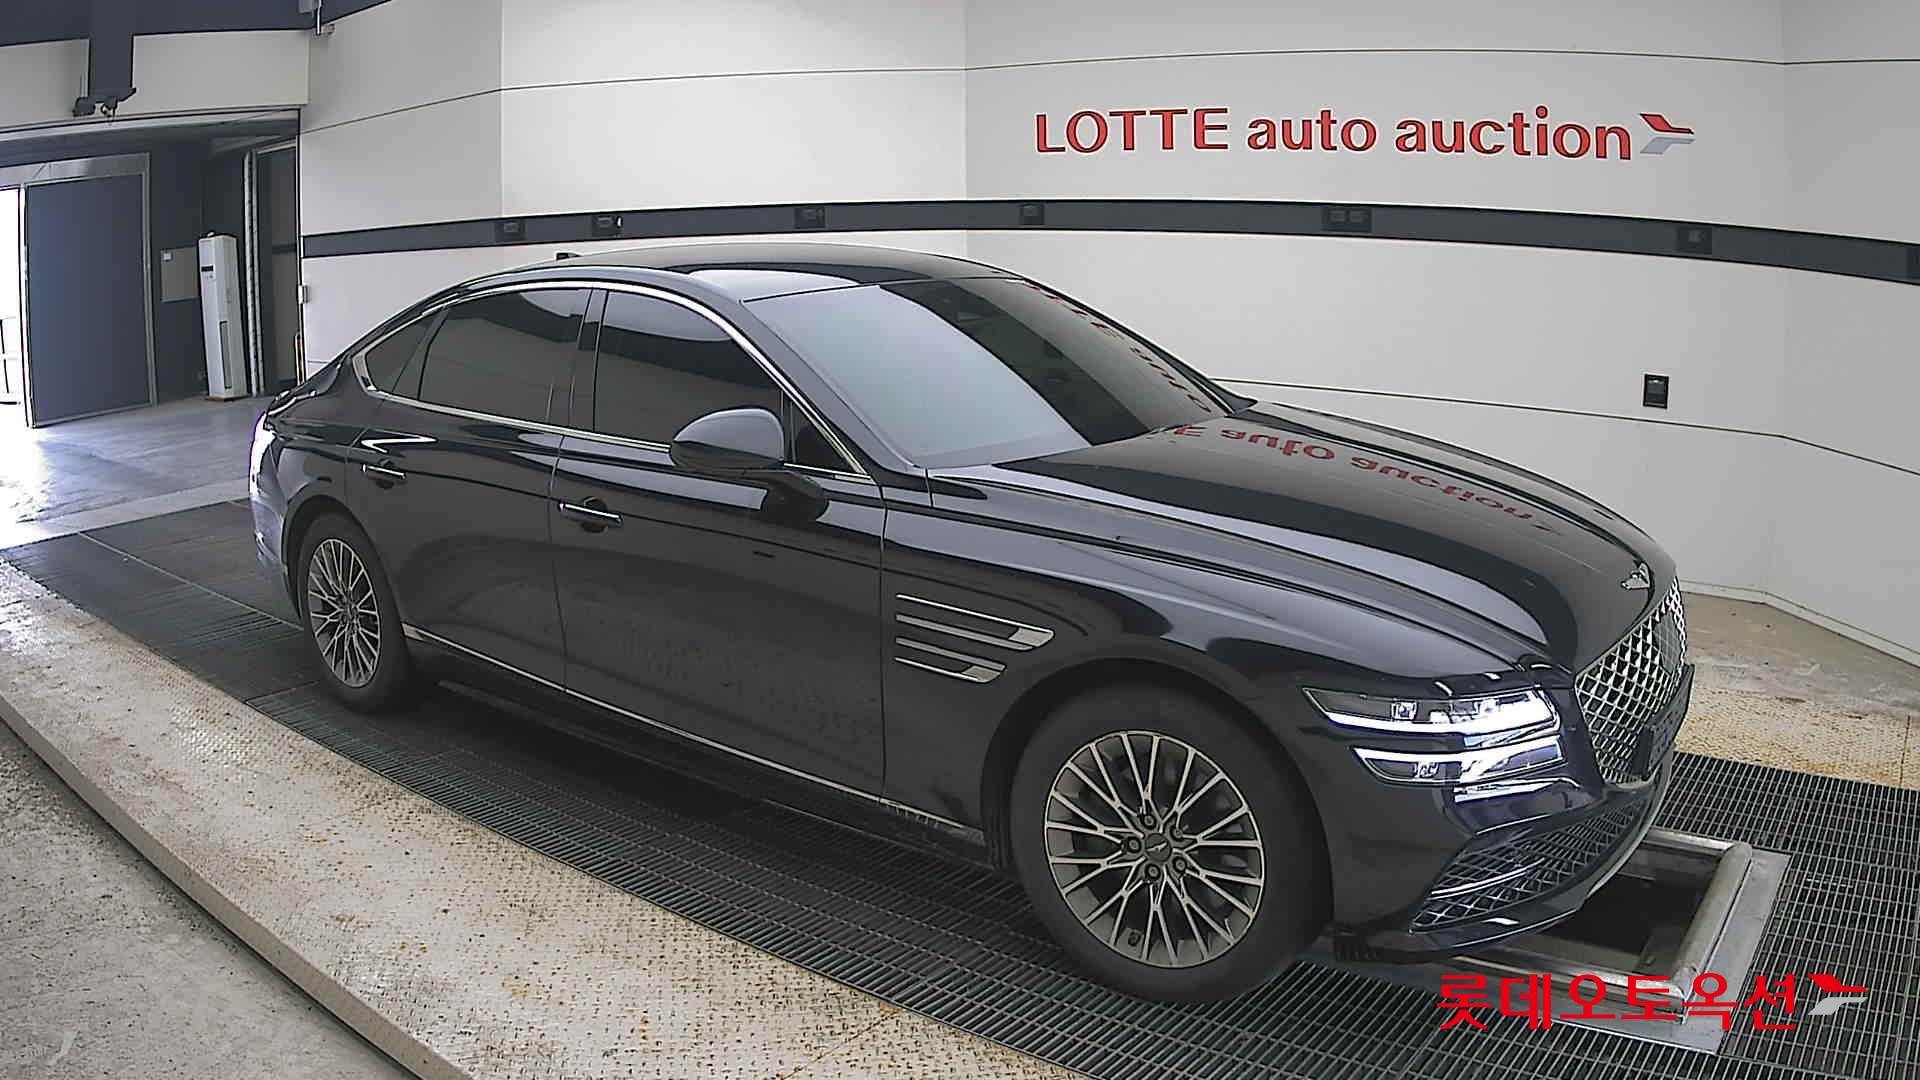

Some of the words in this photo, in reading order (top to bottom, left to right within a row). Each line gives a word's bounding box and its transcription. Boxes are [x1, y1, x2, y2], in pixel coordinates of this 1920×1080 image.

[1035, 108, 1228, 153] LOTTE
[1247, 109, 1378, 152] auto
[1394, 105, 1632, 161] auction
